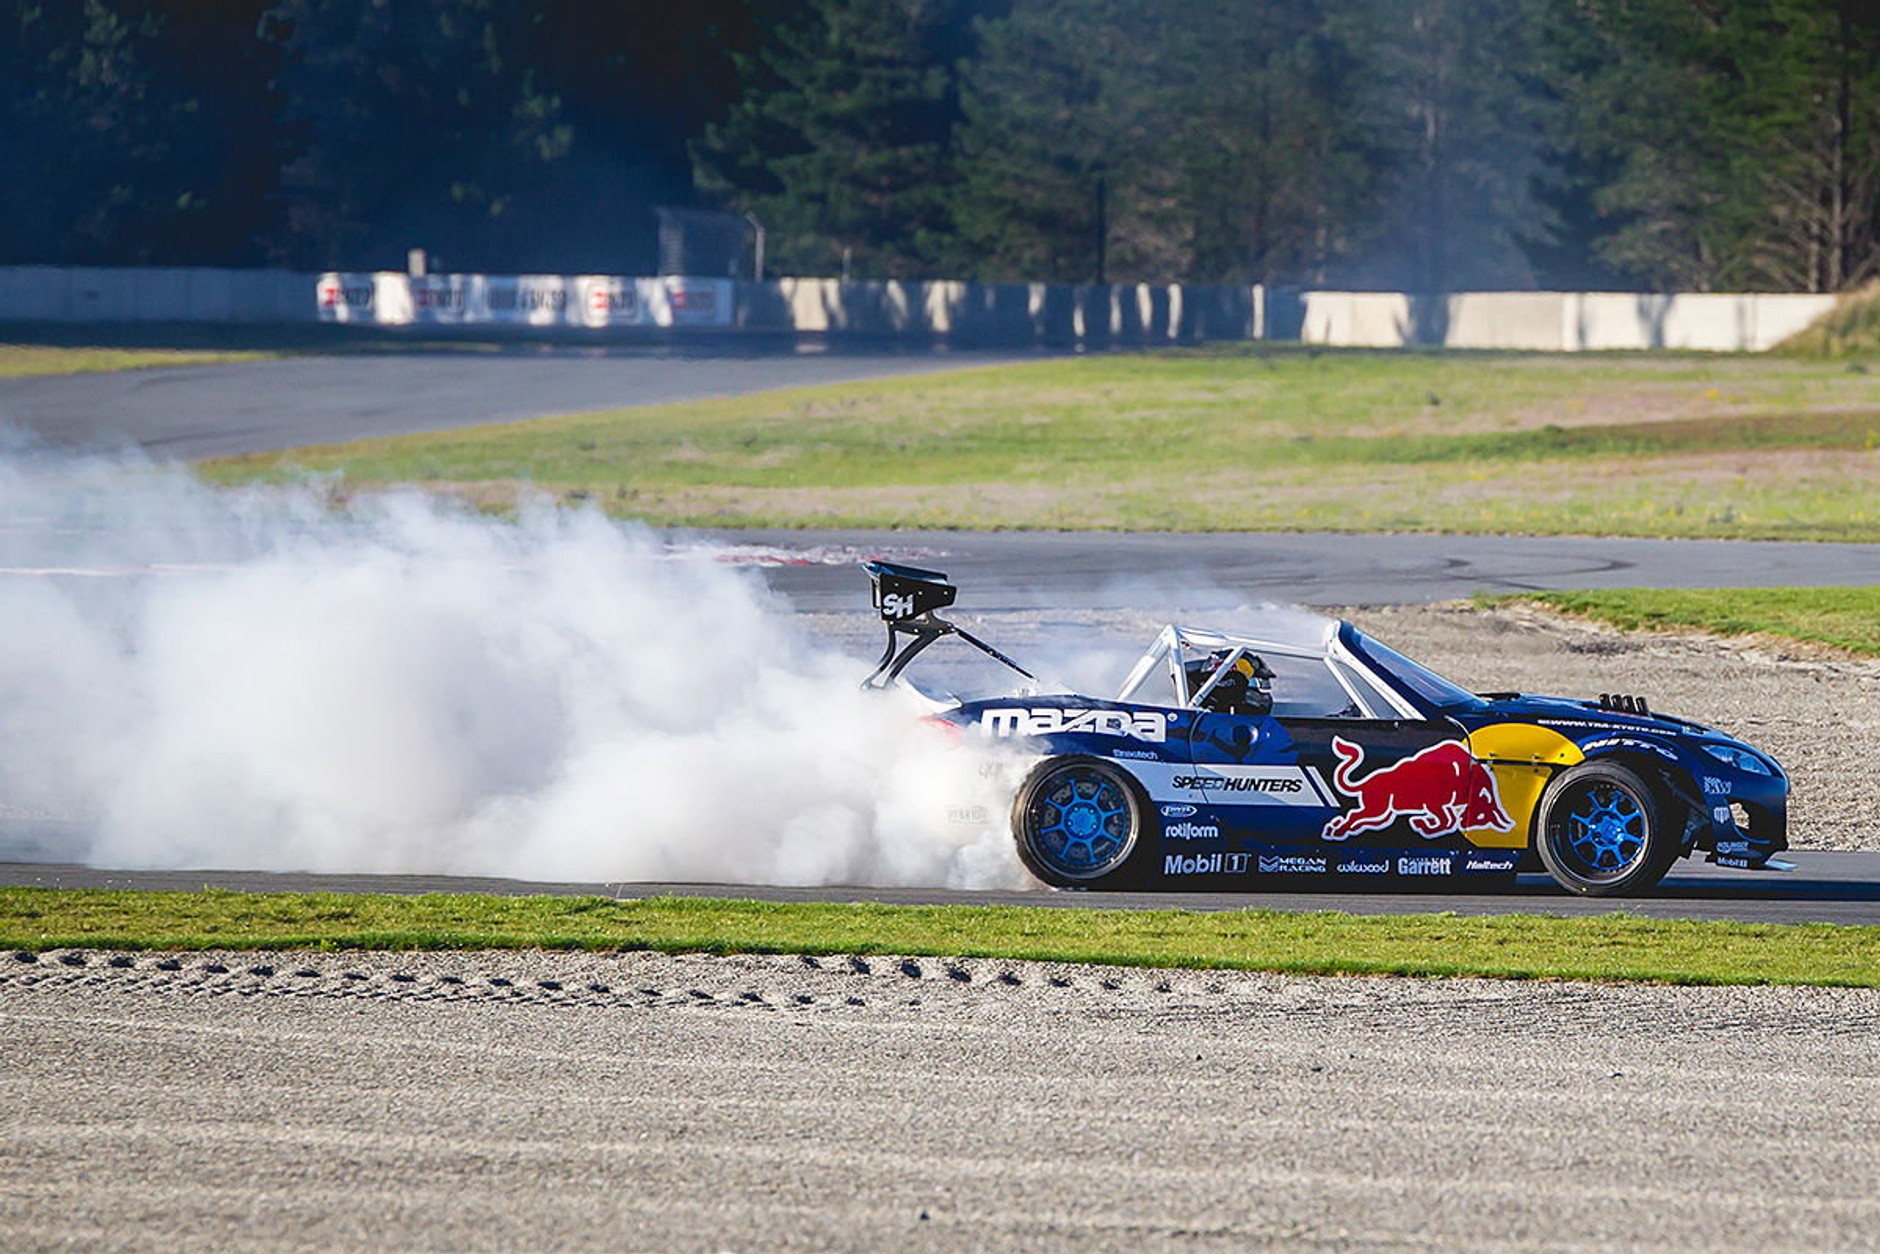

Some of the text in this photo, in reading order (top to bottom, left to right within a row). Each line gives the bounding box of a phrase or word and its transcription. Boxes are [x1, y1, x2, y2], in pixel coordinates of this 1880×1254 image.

[883, 593, 914, 619] SH
[1172, 776, 1303, 792] SPEEDHUNTERS
[1165, 822, 1219, 840] rotiform
[1164, 854, 1221, 874] Mobil
[1398, 857, 1451, 875] Garrett
[1466, 860, 1513, 871] Haltech
